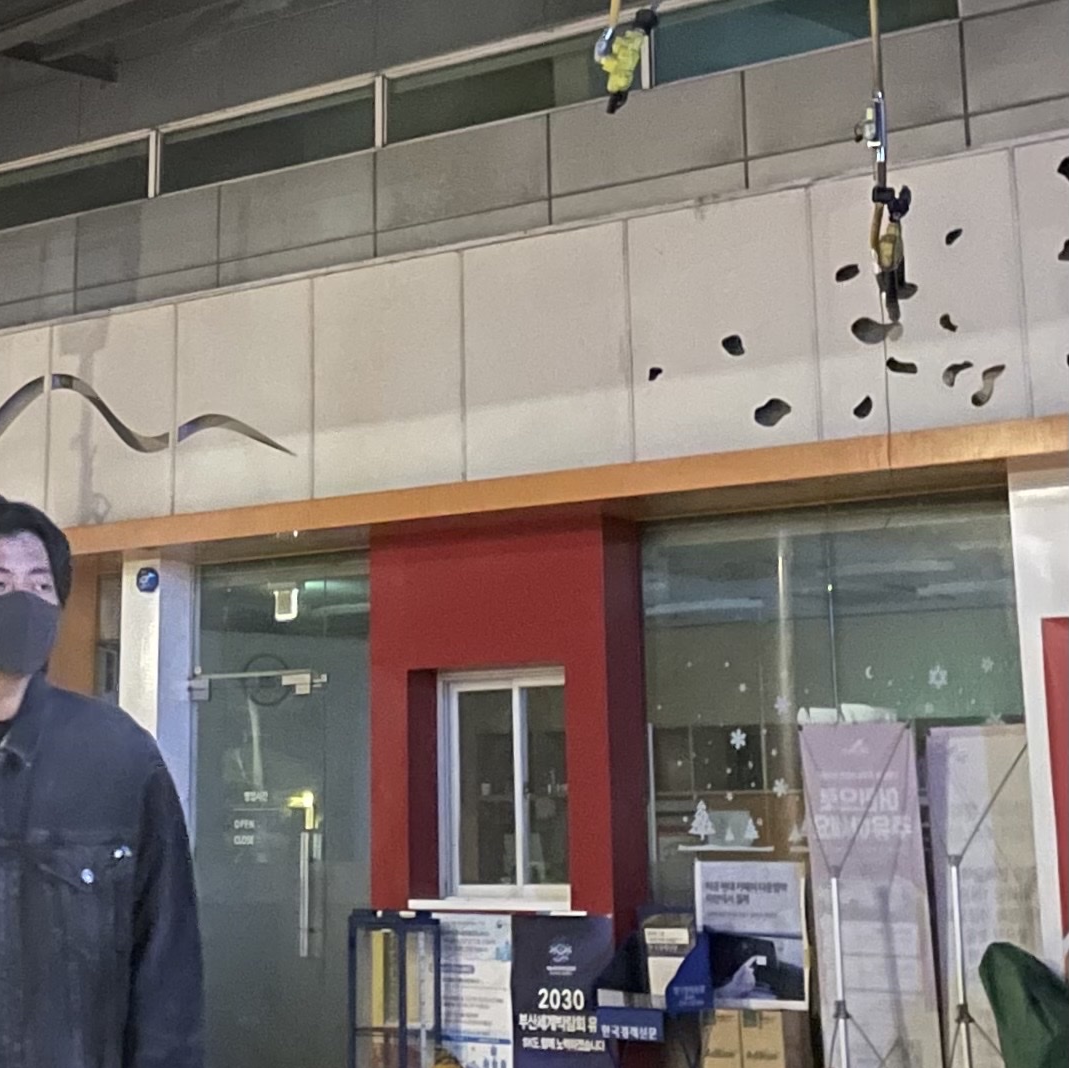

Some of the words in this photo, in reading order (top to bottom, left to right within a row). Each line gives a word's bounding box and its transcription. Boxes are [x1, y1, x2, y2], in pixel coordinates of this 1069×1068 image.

[233, 819, 255, 830] OPEN
[233, 834, 254, 845] CLOSE
[538, 988, 585, 1010] 2030
[600, 1023, 658, 1041] 한국경제신문
